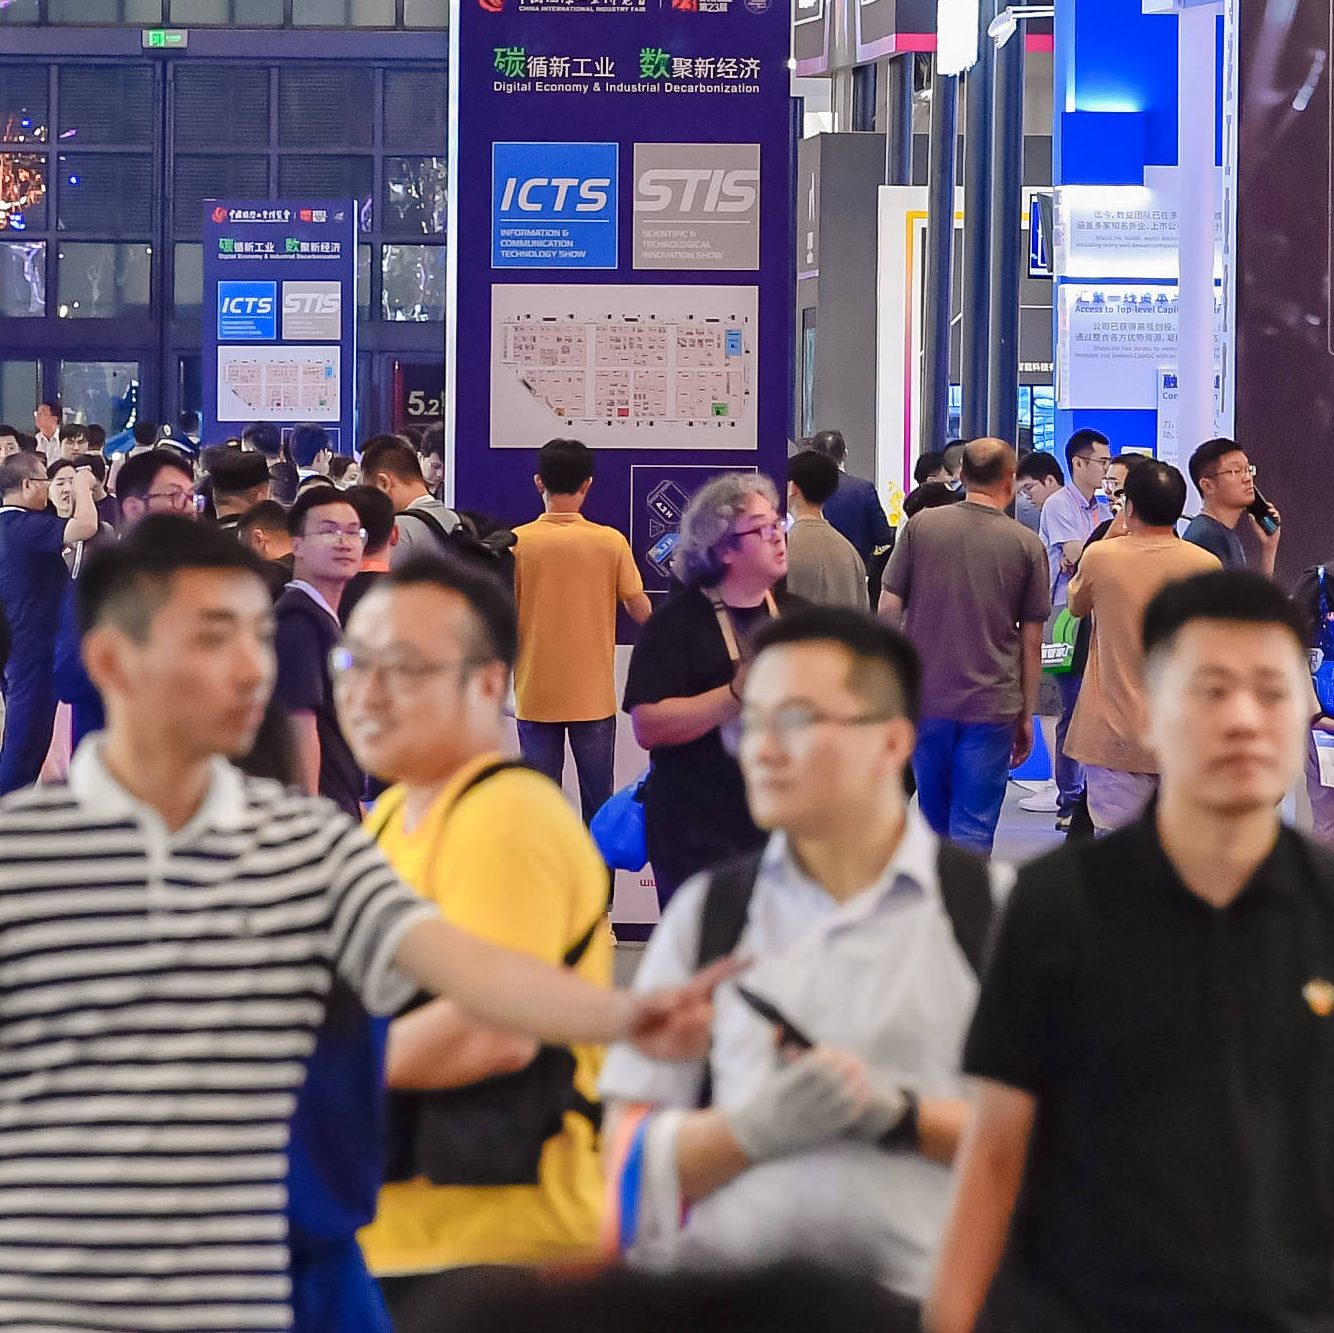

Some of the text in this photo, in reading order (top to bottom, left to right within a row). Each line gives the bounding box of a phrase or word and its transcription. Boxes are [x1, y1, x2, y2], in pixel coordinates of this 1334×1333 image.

[493, 47, 761, 79] 碳循新工业 数聚新经济
[493, 81, 760, 94] Digital Economy & Industrial Decarbonization
[500, 177, 611, 212] ICTS
[634, 169, 759, 212] STIS
[500, 229, 561, 237] INFORMATION
[500, 239, 574, 248] COMMUNICATION
[501, 250, 586, 258] TECHNOLOGY SHOW
[221, 297, 273, 314] ICTS
[283, 293, 341, 314] STIS
[1075, 305, 1103, 313] Access
[1105, 305, 1114, 313] to
[1117, 305, 1155, 315] Top-level
